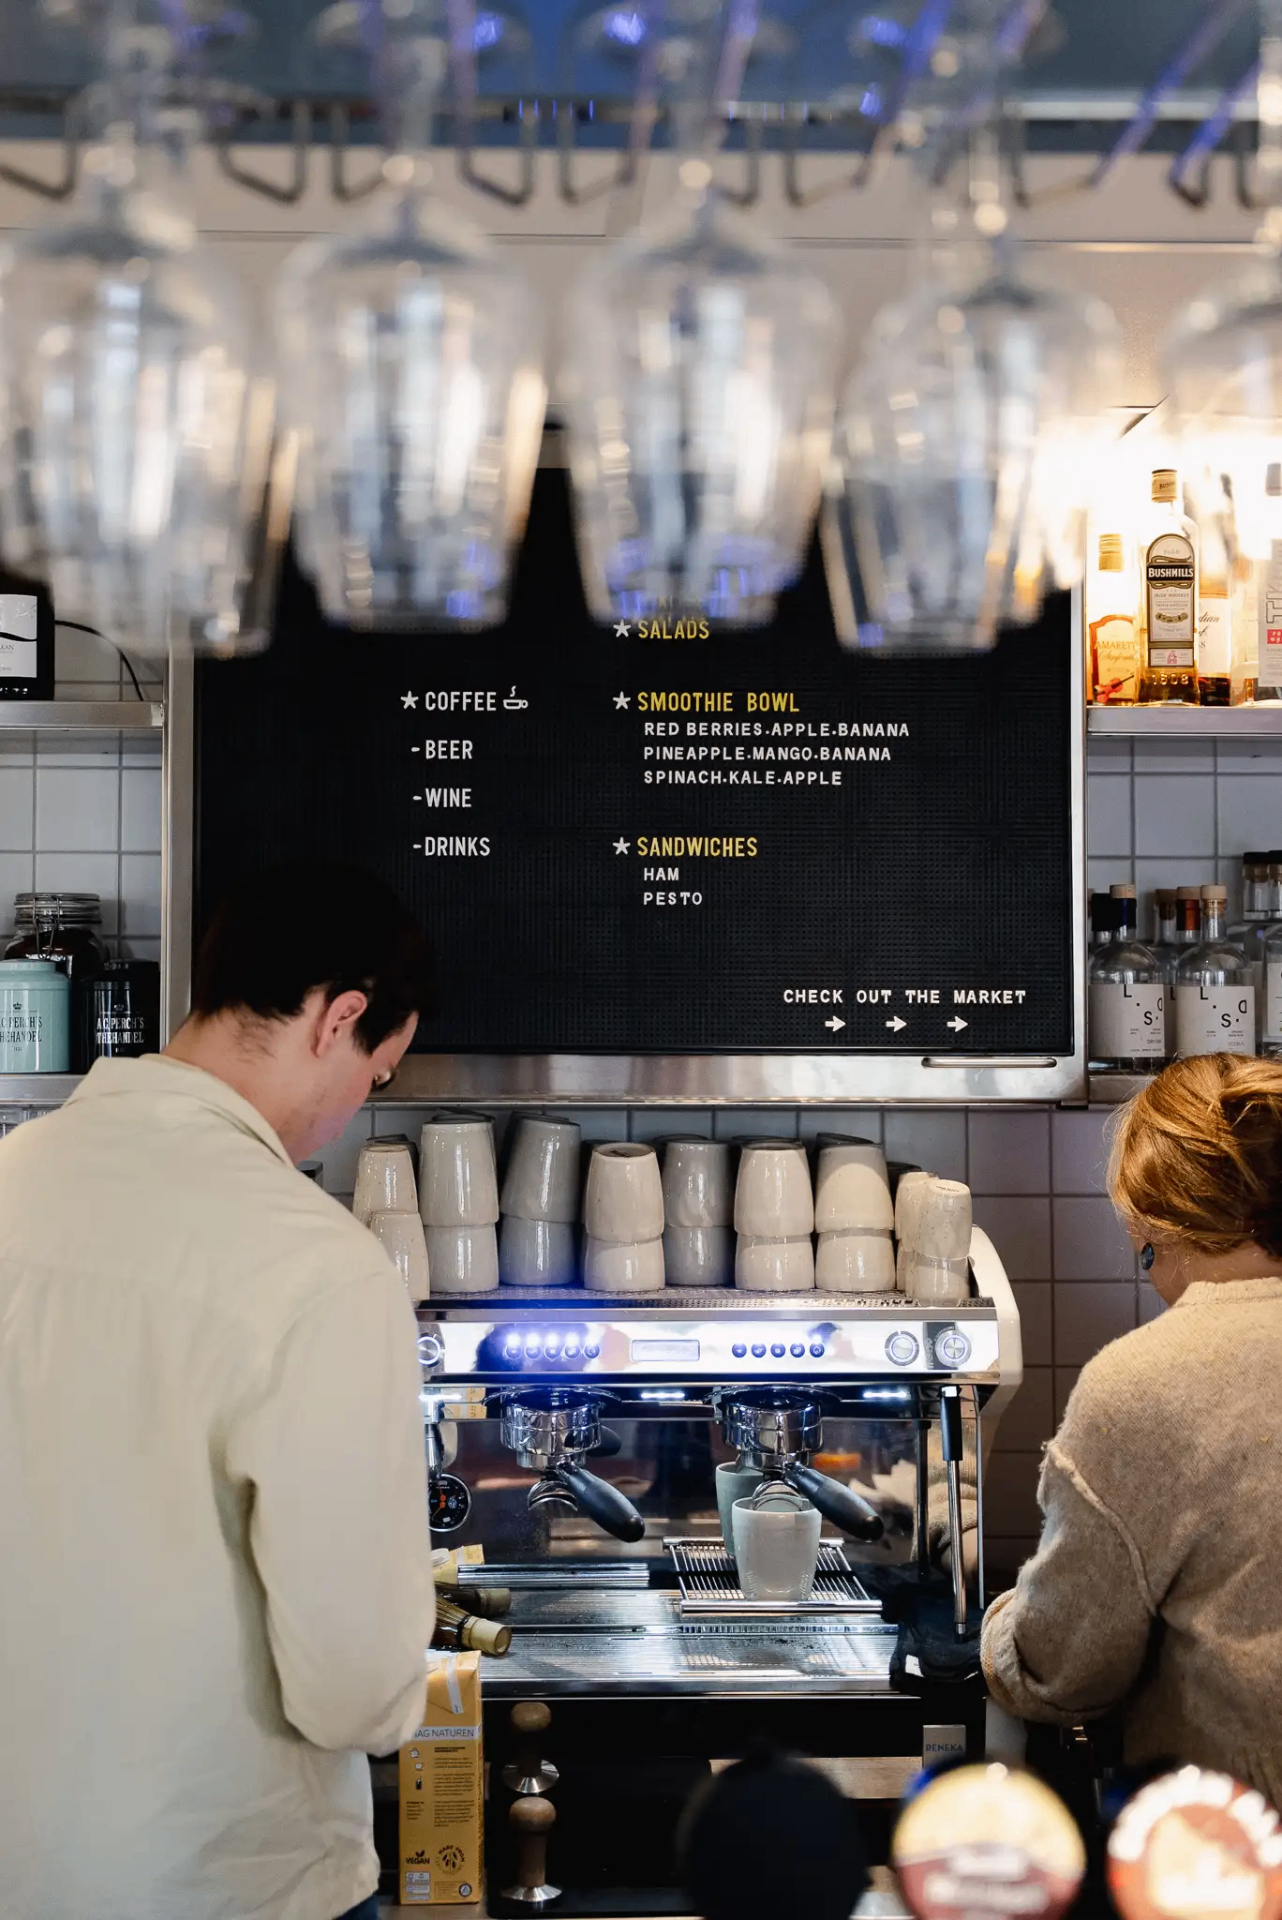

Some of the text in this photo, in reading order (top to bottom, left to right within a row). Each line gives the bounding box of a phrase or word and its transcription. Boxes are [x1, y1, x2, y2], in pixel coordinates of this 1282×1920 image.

[1148, 567, 1194, 578] BUSHMILLS
[637, 620, 710, 640] SALADS
[425, 691, 497, 712] COFFEE
[637, 691, 800, 713] SMOOTHIE BOWL
[644, 722, 680, 737] RED
[637, 836, 758, 858] SANDWICHES
[643, 867, 680, 882] HAM
[643, 891, 703, 906] PESTO
[783, 988, 1026, 1005] CHECK OUT THE MARKET
[0, 1030, 42, 1043] HEHANDEL
[431, 1728, 475, 1738] NATUREN
[405, 1857, 431, 1865] VEGAN
